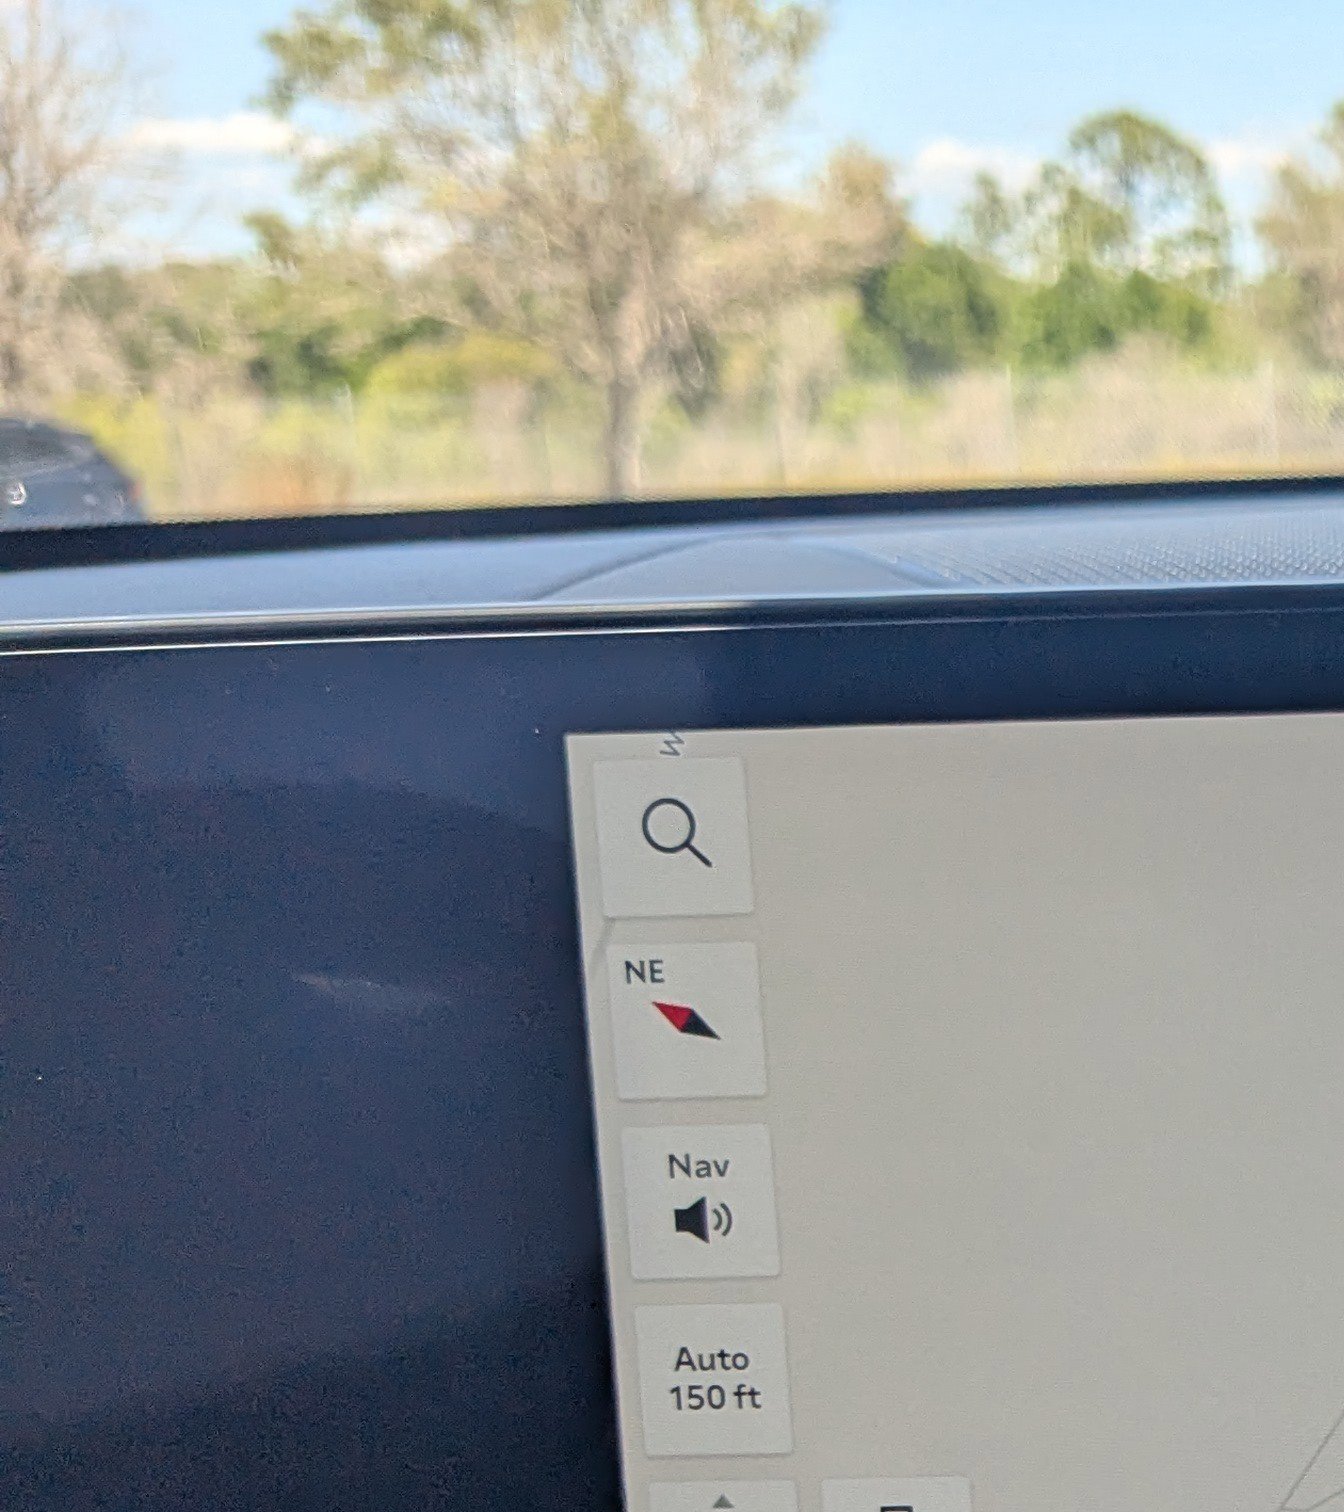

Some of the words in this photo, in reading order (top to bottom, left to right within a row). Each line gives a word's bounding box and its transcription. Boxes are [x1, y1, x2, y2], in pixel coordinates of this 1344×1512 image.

[624, 959, 665, 984] NE
[667, 1153, 730, 1179] Nav
[674, 1346, 750, 1372] Auto
[669, 1384, 726, 1411] 150
[732, 1382, 762, 1410] ft
